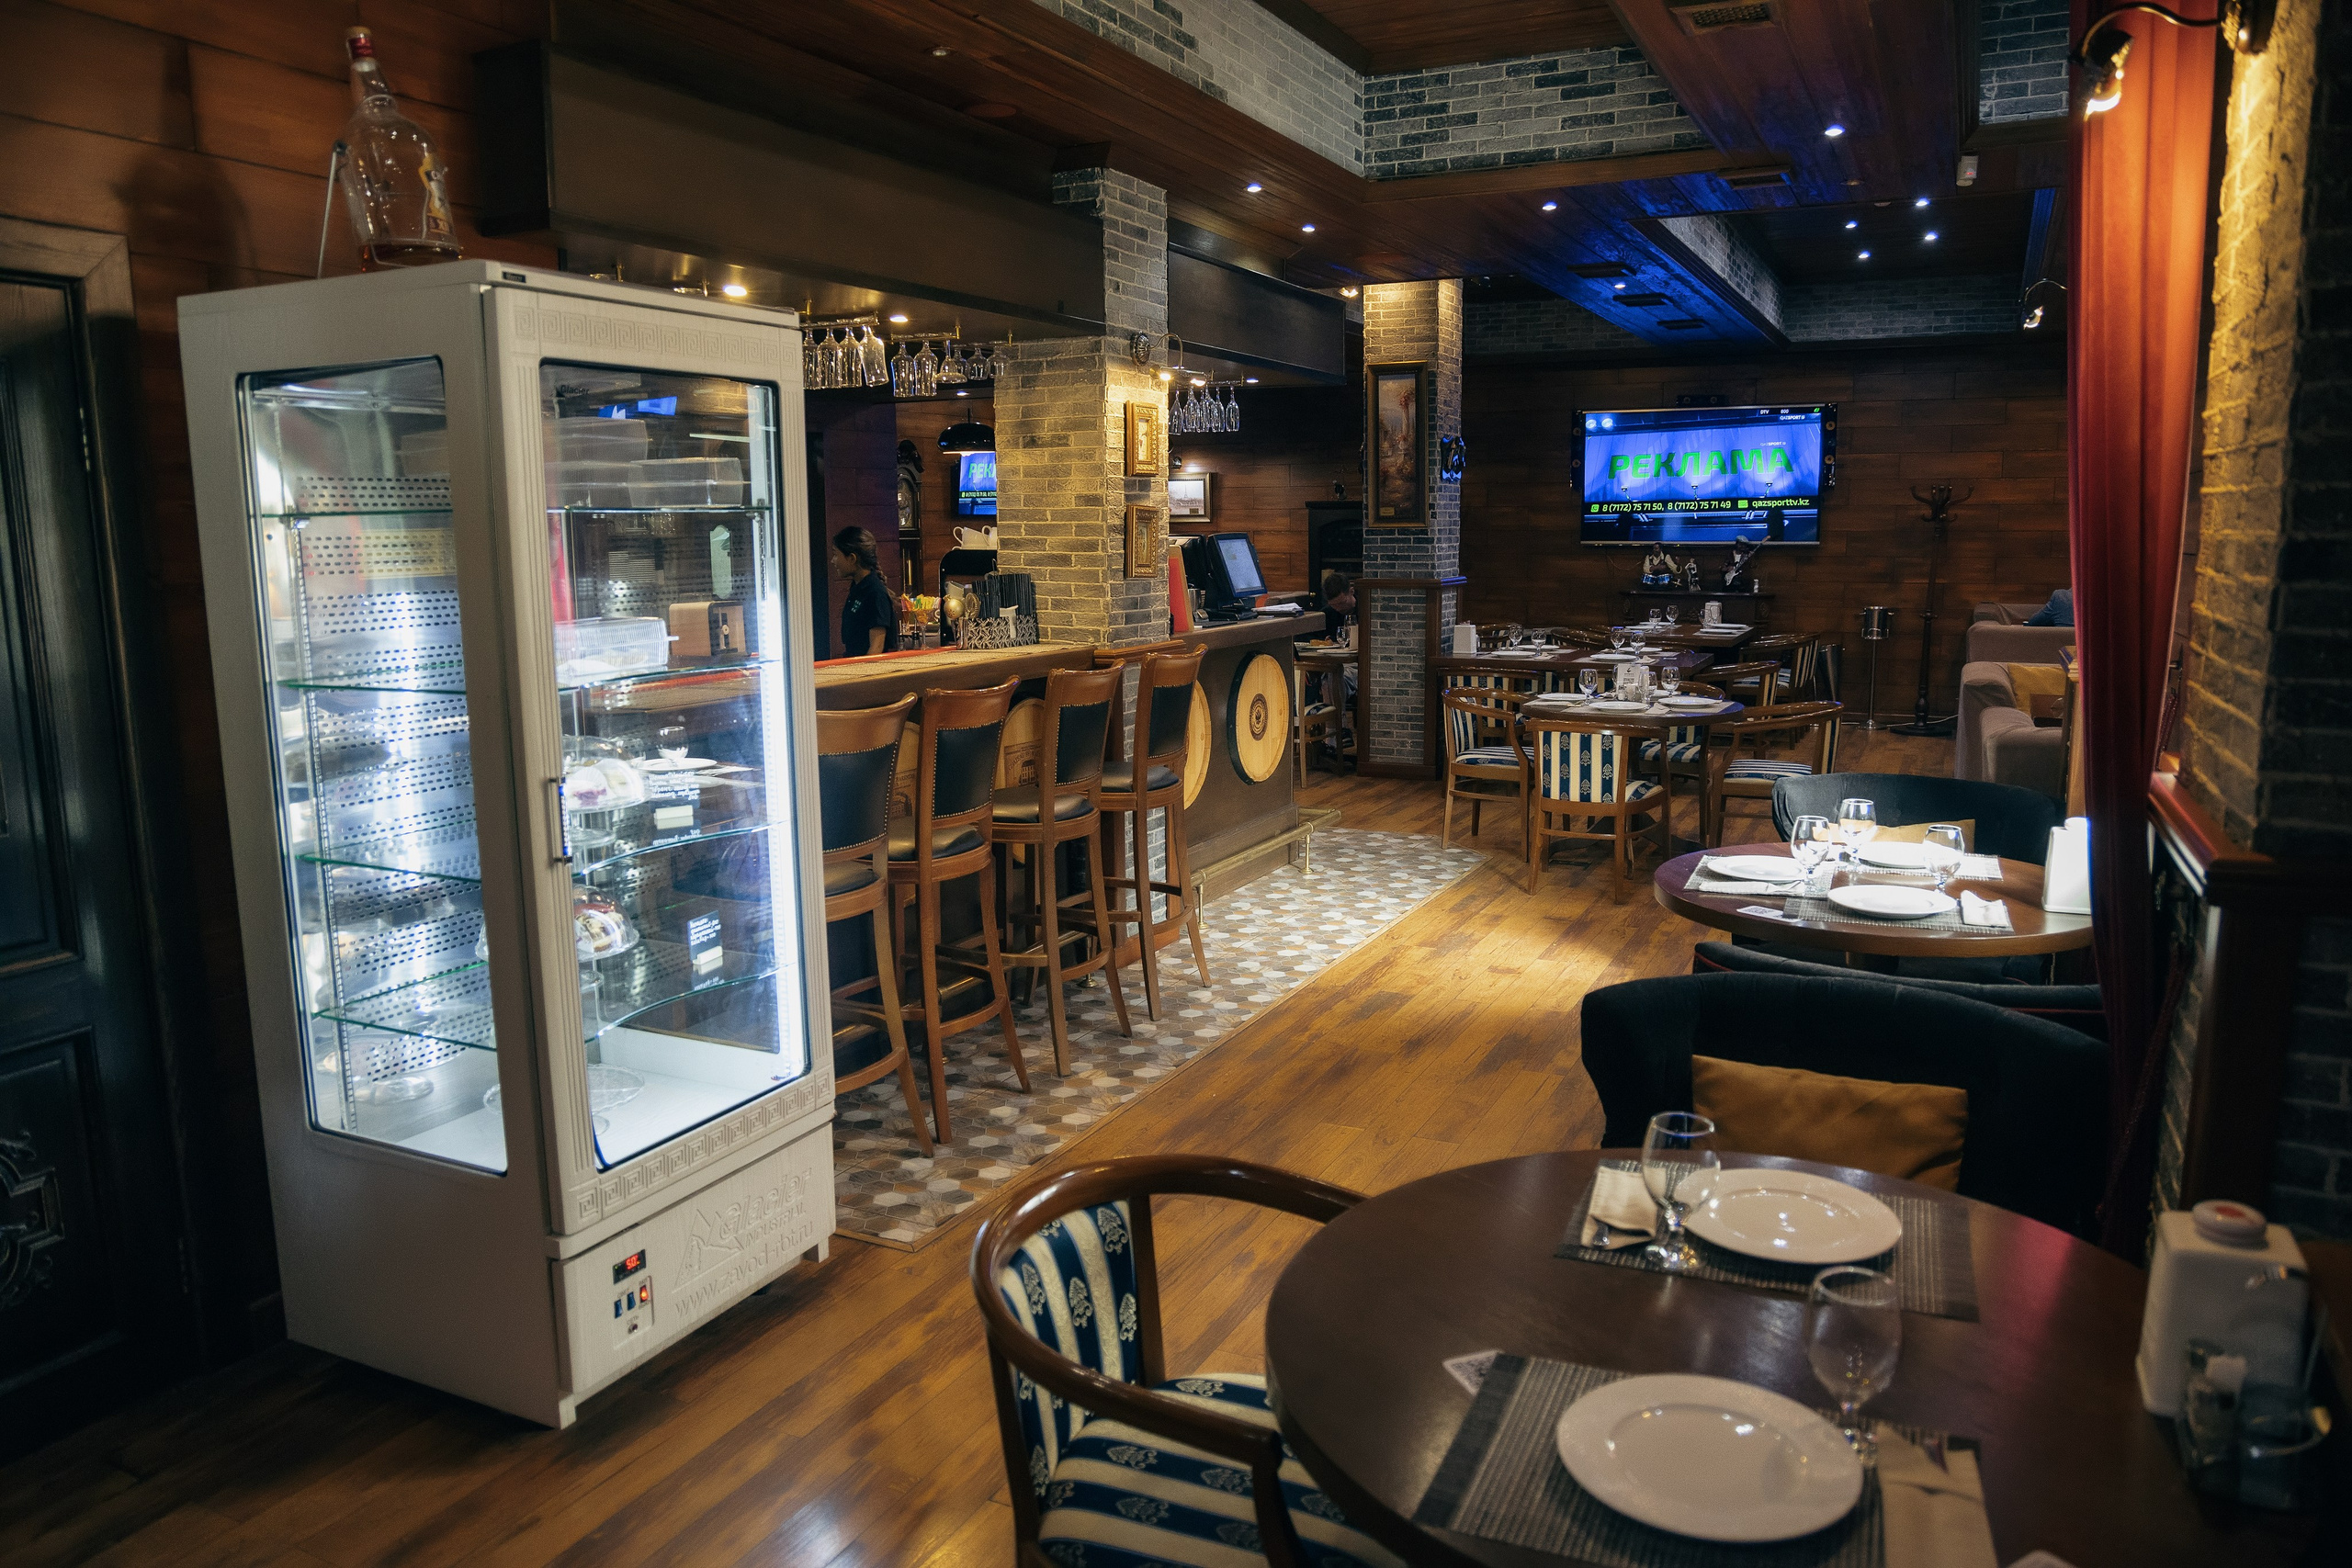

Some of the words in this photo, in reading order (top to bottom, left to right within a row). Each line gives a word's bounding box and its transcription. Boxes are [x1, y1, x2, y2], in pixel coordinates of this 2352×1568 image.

[1608, 447, 1794, 479] РЕКЛАМА
[1609, 503, 1632, 513] (7172)
[1674, 502, 1698, 511] (7172)
[1710, 501, 1719, 509] 71
[1720, 501, 1731, 509] 49
[1752, 498, 1810, 508] qazsporttv.kz
[719, 1168, 812, 1240] Glacier
[745, 1202, 807, 1247] INDUSTRIAL
